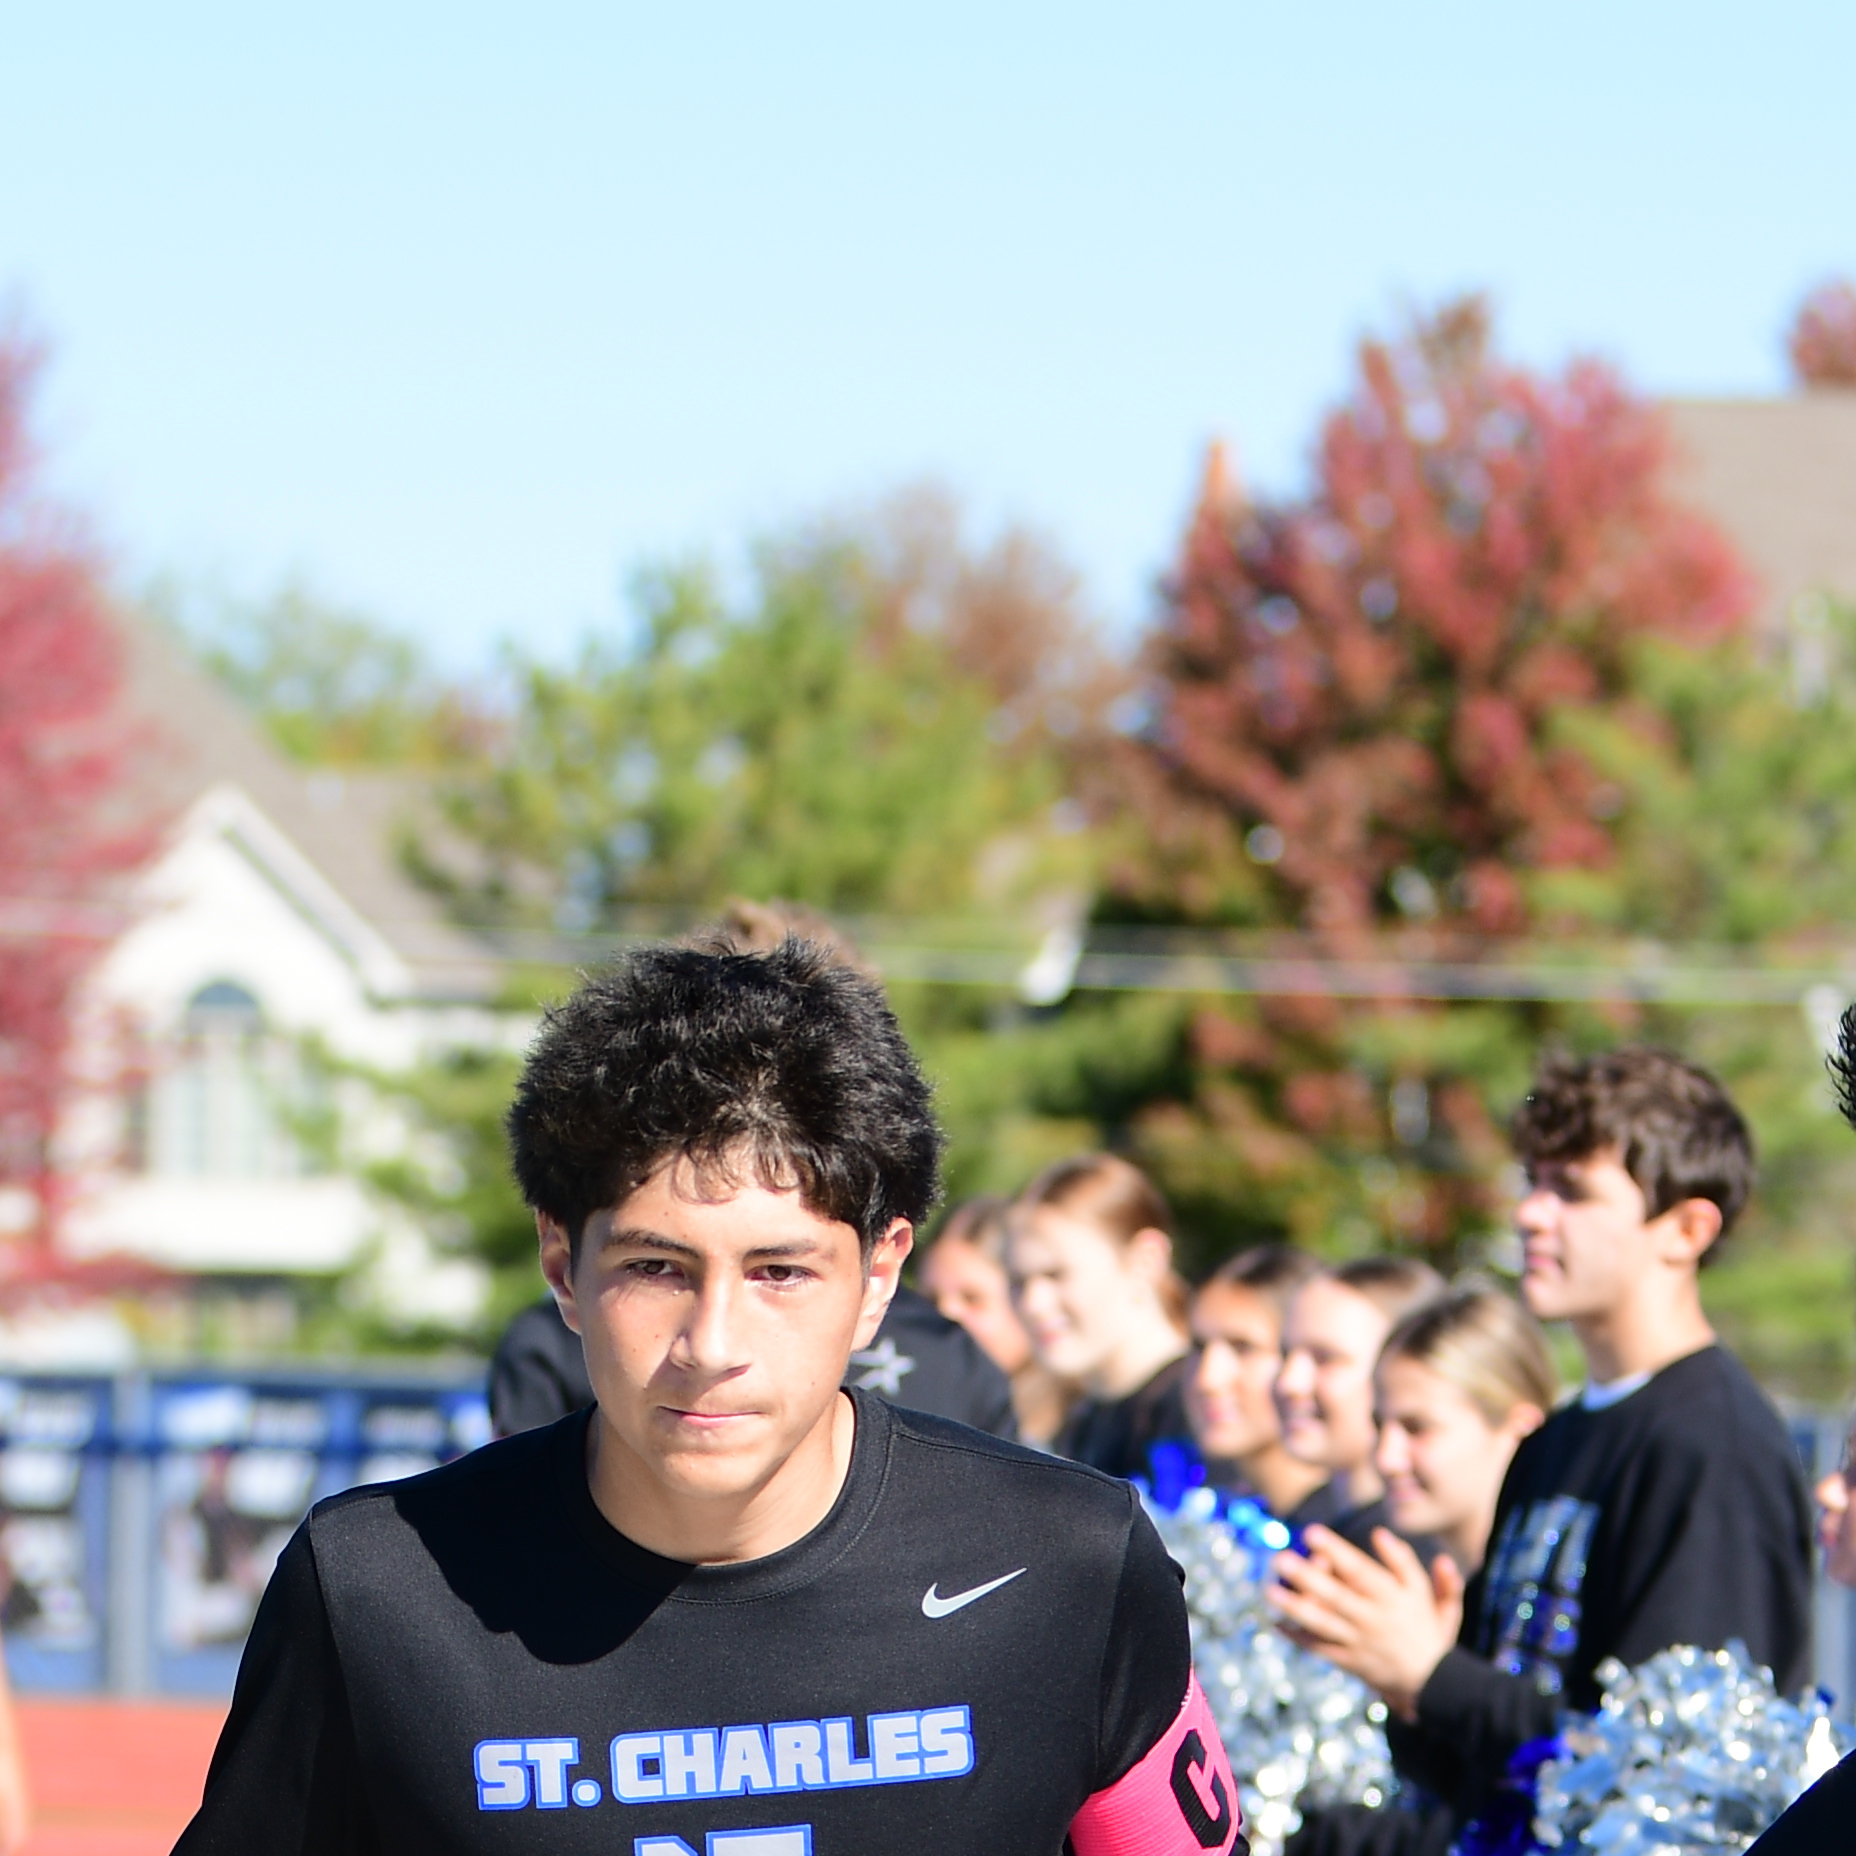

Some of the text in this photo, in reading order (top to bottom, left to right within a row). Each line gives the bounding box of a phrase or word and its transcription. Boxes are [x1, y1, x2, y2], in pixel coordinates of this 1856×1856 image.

[473, 1705, 973, 1810] ST. CHARLES
[1170, 1730, 1228, 1848] C
